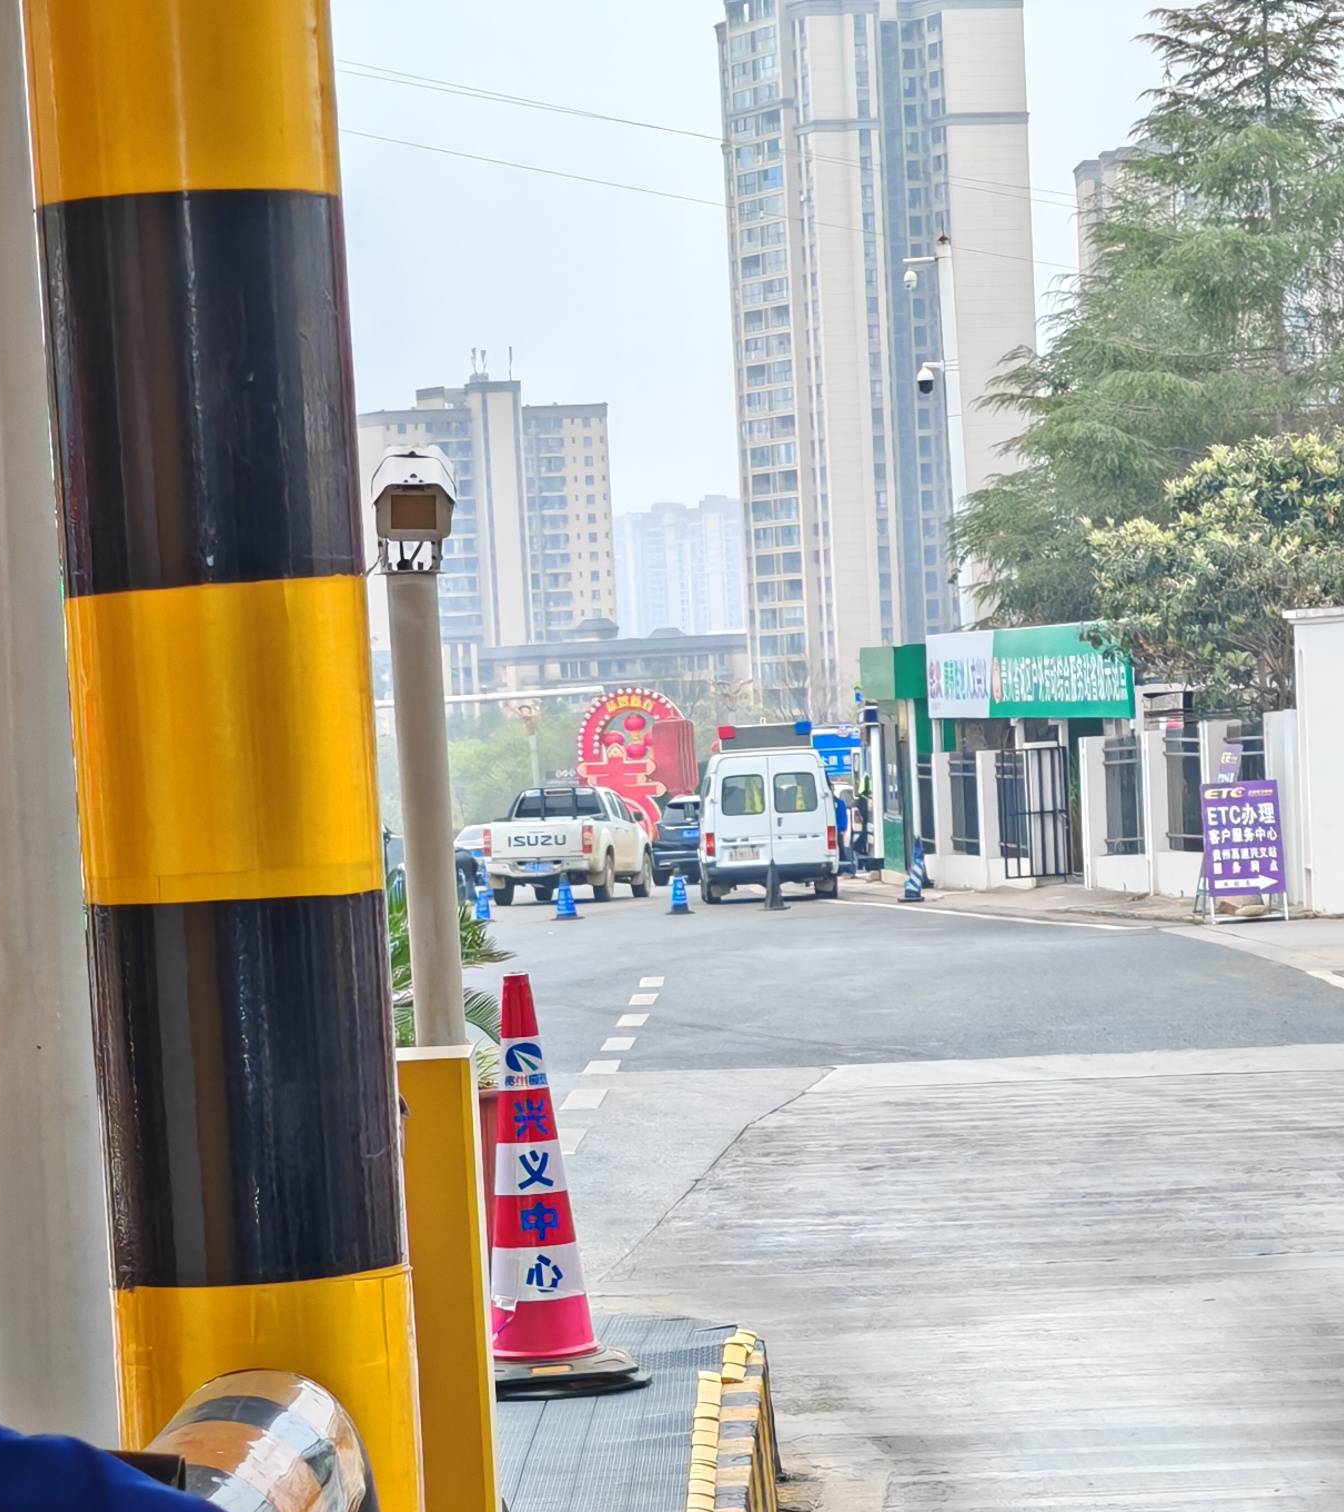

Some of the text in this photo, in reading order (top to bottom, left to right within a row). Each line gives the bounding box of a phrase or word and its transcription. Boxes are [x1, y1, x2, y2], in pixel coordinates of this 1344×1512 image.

[1204, 787, 1246, 799] ETC
[1207, 803, 1276, 825] ETC办理
[507, 834, 567, 847] ISUZU
[1208, 826, 1278, 845] 客户服务中心
[513, 1097, 564, 1293] 兴义中心
